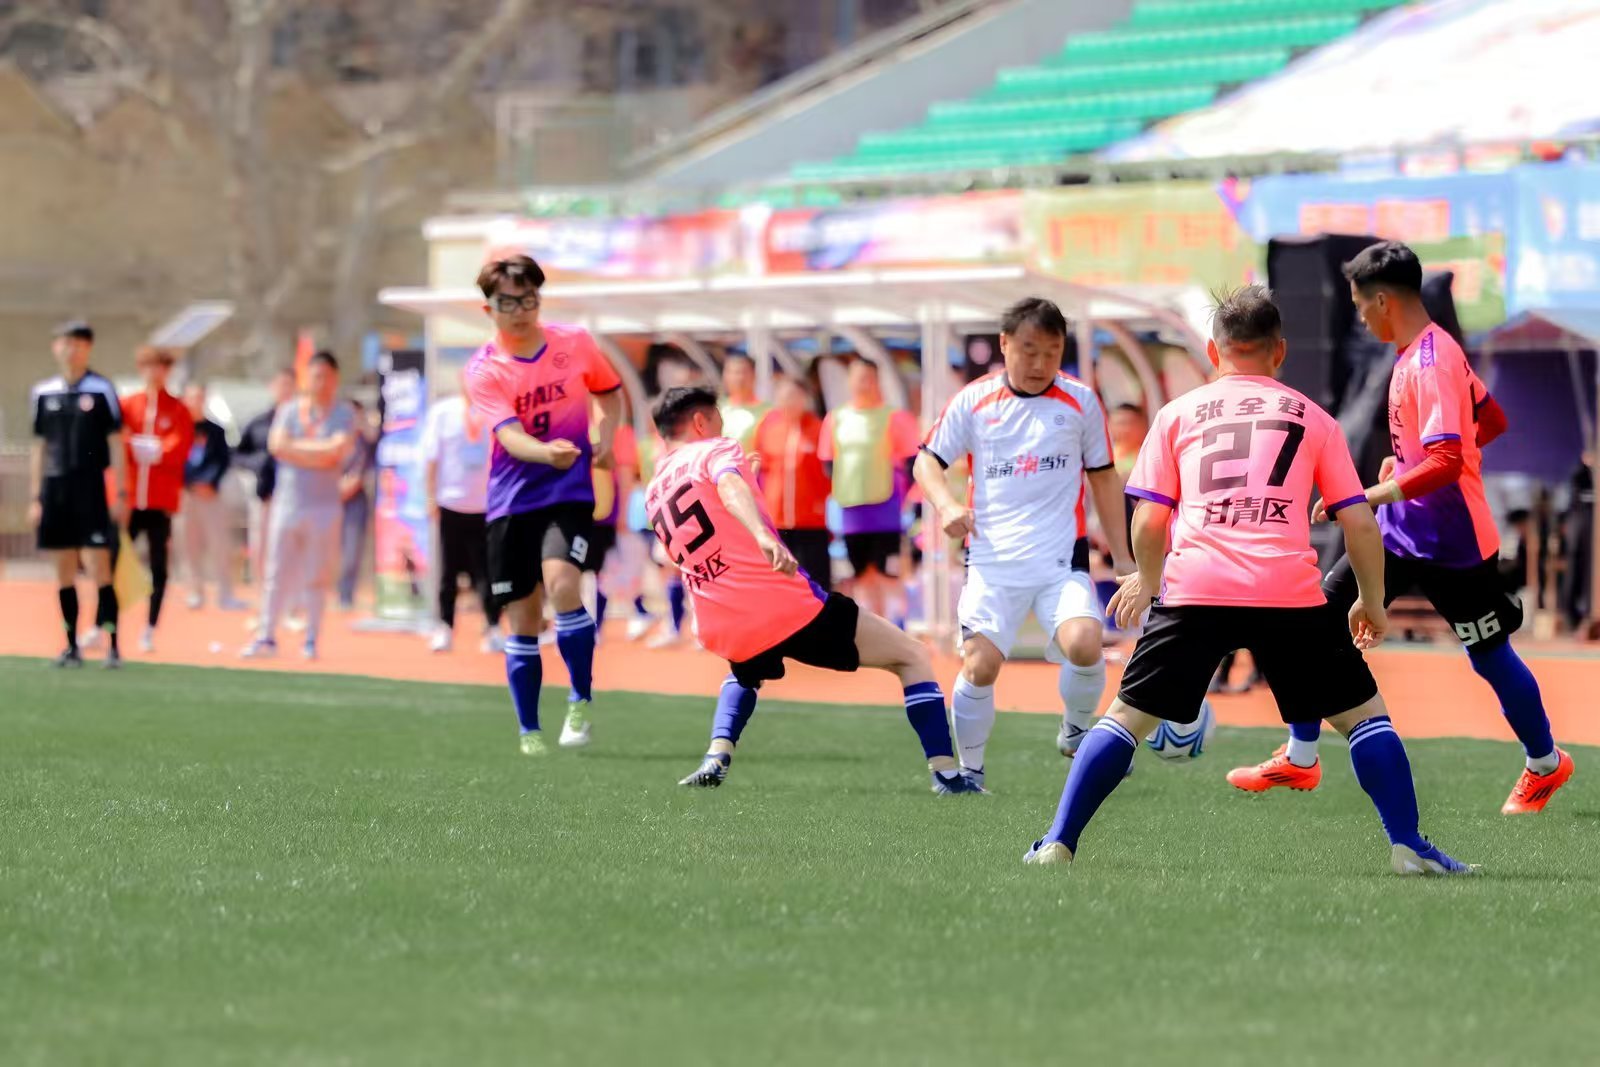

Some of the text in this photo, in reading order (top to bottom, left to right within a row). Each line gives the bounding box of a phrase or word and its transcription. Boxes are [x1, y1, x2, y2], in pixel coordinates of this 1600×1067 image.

[533, 410, 551, 438] 9
[1195, 396, 1306, 424] 张全君
[1199, 420, 1306, 495] 27
[1202, 496, 1293, 529] 甘青区
[569, 535, 589, 564] 9
[1454, 611, 1502, 647] 96
